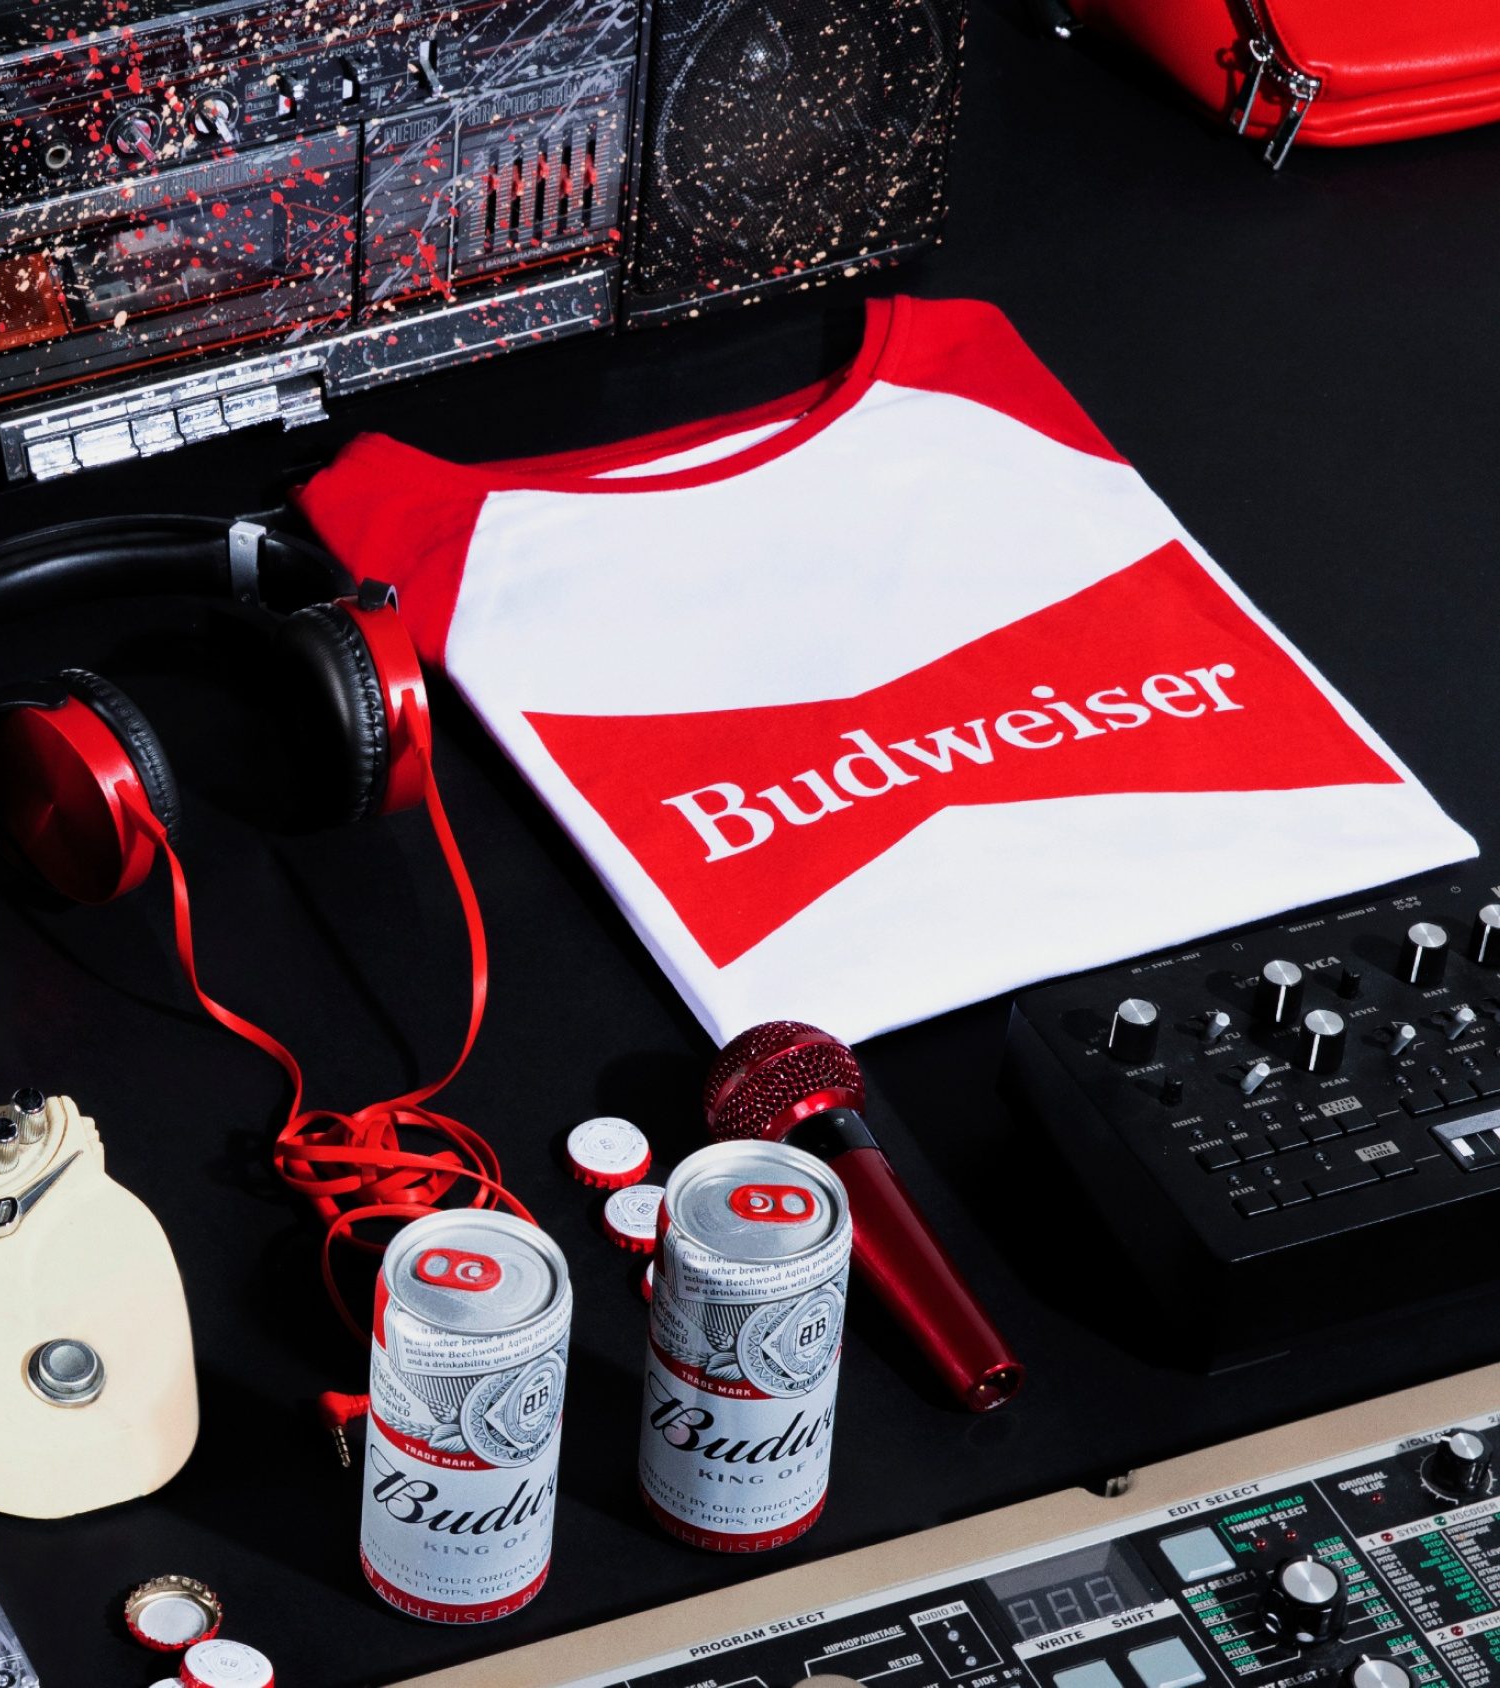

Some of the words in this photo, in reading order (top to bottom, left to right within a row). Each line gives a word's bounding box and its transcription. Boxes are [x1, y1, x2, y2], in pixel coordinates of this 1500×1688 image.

[121, 96, 155, 109] OLUME
[486, 256, 509, 268] BAND
[1, 335, 26, 346] AUTO
[145, 328, 168, 340] JECT
[661, 662, 1245, 864] Budweiser
[1337, 910, 1365, 920] AUDIO
[1288, 920, 1326, 933] OUTPUT
[1304, 956, 1341, 970] VCA
[1423, 988, 1449, 998] RATE
[1350, 1007, 1379, 1018] LEVEL
[1204, 1045, 1233, 1055] WAVE
[1445, 1040, 1485, 1054] TARGET
[1126, 1063, 1165, 1077] OCTAVE
[1320, 1077, 1349, 1088] PEAK
[1243, 1095, 1280, 1109] RANGE
[1320, 1097, 1356, 1110] ACTIVE
[1172, 1116, 1203, 1128] NOISE
[1188, 1138, 1223, 1152] SYNTH
[1366, 1149, 1392, 1159] TIME
[1229, 1186, 1255, 1198] FLUX
[684, 1275, 721, 1285] exclusive
[726, 1273, 781, 1287] Beechwood
[785, 1265, 810, 1279] Aging
[712, 1267, 735, 1275] other
[740, 1265, 771, 1275] brewer
[710, 1287, 767, 1297] drinkability
[800, 1317, 826, 1346] AB
[406, 1348, 446, 1358] exclusive
[448, 1343, 504, 1358] Beechwood
[508, 1335, 533, 1350] Aging
[434, 1338, 458, 1347] other
[461, 1335, 492, 1346] brewer
[432, 1358, 490, 1369] drinkability
[682, 1371, 713, 1390] TRADE
[718, 1385, 751, 1396] MARK
[405, 1444, 437, 1462] TRADE
[442, 1457, 475, 1468] MARK
[699, 1468, 764, 1484] KING
[778, 1462, 806, 1479] OF
[1338, 1471, 1388, 1491] ORIGINAL
[1351, 1482, 1386, 1496] VALUE
[690, 1496, 707, 1508] BY
[713, 1504, 745, 1514] OUR
[751, 1488, 812, 1513] ORIGINAL
[1168, 1502, 1201, 1517] EDIT
[1206, 1484, 1260, 1506] SELECT
[1223, 1503, 1273, 1524] FORMANT
[1275, 1496, 1304, 1508] HOLD
[702, 1513, 747, 1526] HOPS,
[754, 1512, 787, 1524] RICE
[1229, 1516, 1270, 1534] TIMBRE
[1271, 1505, 1308, 1522] SELECT
[1396, 1522, 1432, 1537] SYNTH
[1451, 1502, 1498, 1521] VOCODER
[424, 1542, 489, 1555] KING
[504, 1530, 531, 1549] OF
[1313, 1536, 1342, 1549] FILTER
[1317, 1543, 1346, 1555] FILTER
[415, 1570, 431, 1580] BY
[438, 1575, 471, 1585] OUR
[477, 1555, 537, 1583] ORIGINAL
[427, 1585, 474, 1597] HOPS,
[480, 1580, 513, 1595] RICE
[1181, 1584, 1207, 1598] EDIT
[1208, 1571, 1247, 1590] SELECT
[377, 1576, 547, 1623] ANHEUSER-BU
[917, 1609, 948, 1623] AUDIO
[1112, 1610, 1154, 1628] SHIFT
[1198, 1607, 1225, 1619] AUDIO
[690, 1629, 766, 1657] PROGRAM
[769, 1612, 825, 1634] SELECT
[823, 1625, 904, 1654] HIPHOP/VINTAGE
[1036, 1631, 1085, 1650] WRITE
[1386, 1634, 1413, 1647] DELAY
[1221, 1640, 1247, 1651] PITCH
[1225, 1646, 1251, 1658] PITCH
[1390, 1640, 1418, 1654] DELAY
[888, 1654, 922, 1669] RETRO
[1231, 1655, 1257, 1667] VOICE
[1235, 1661, 1261, 1673] VOICE
[972, 1675, 997, 1688] SIDE
